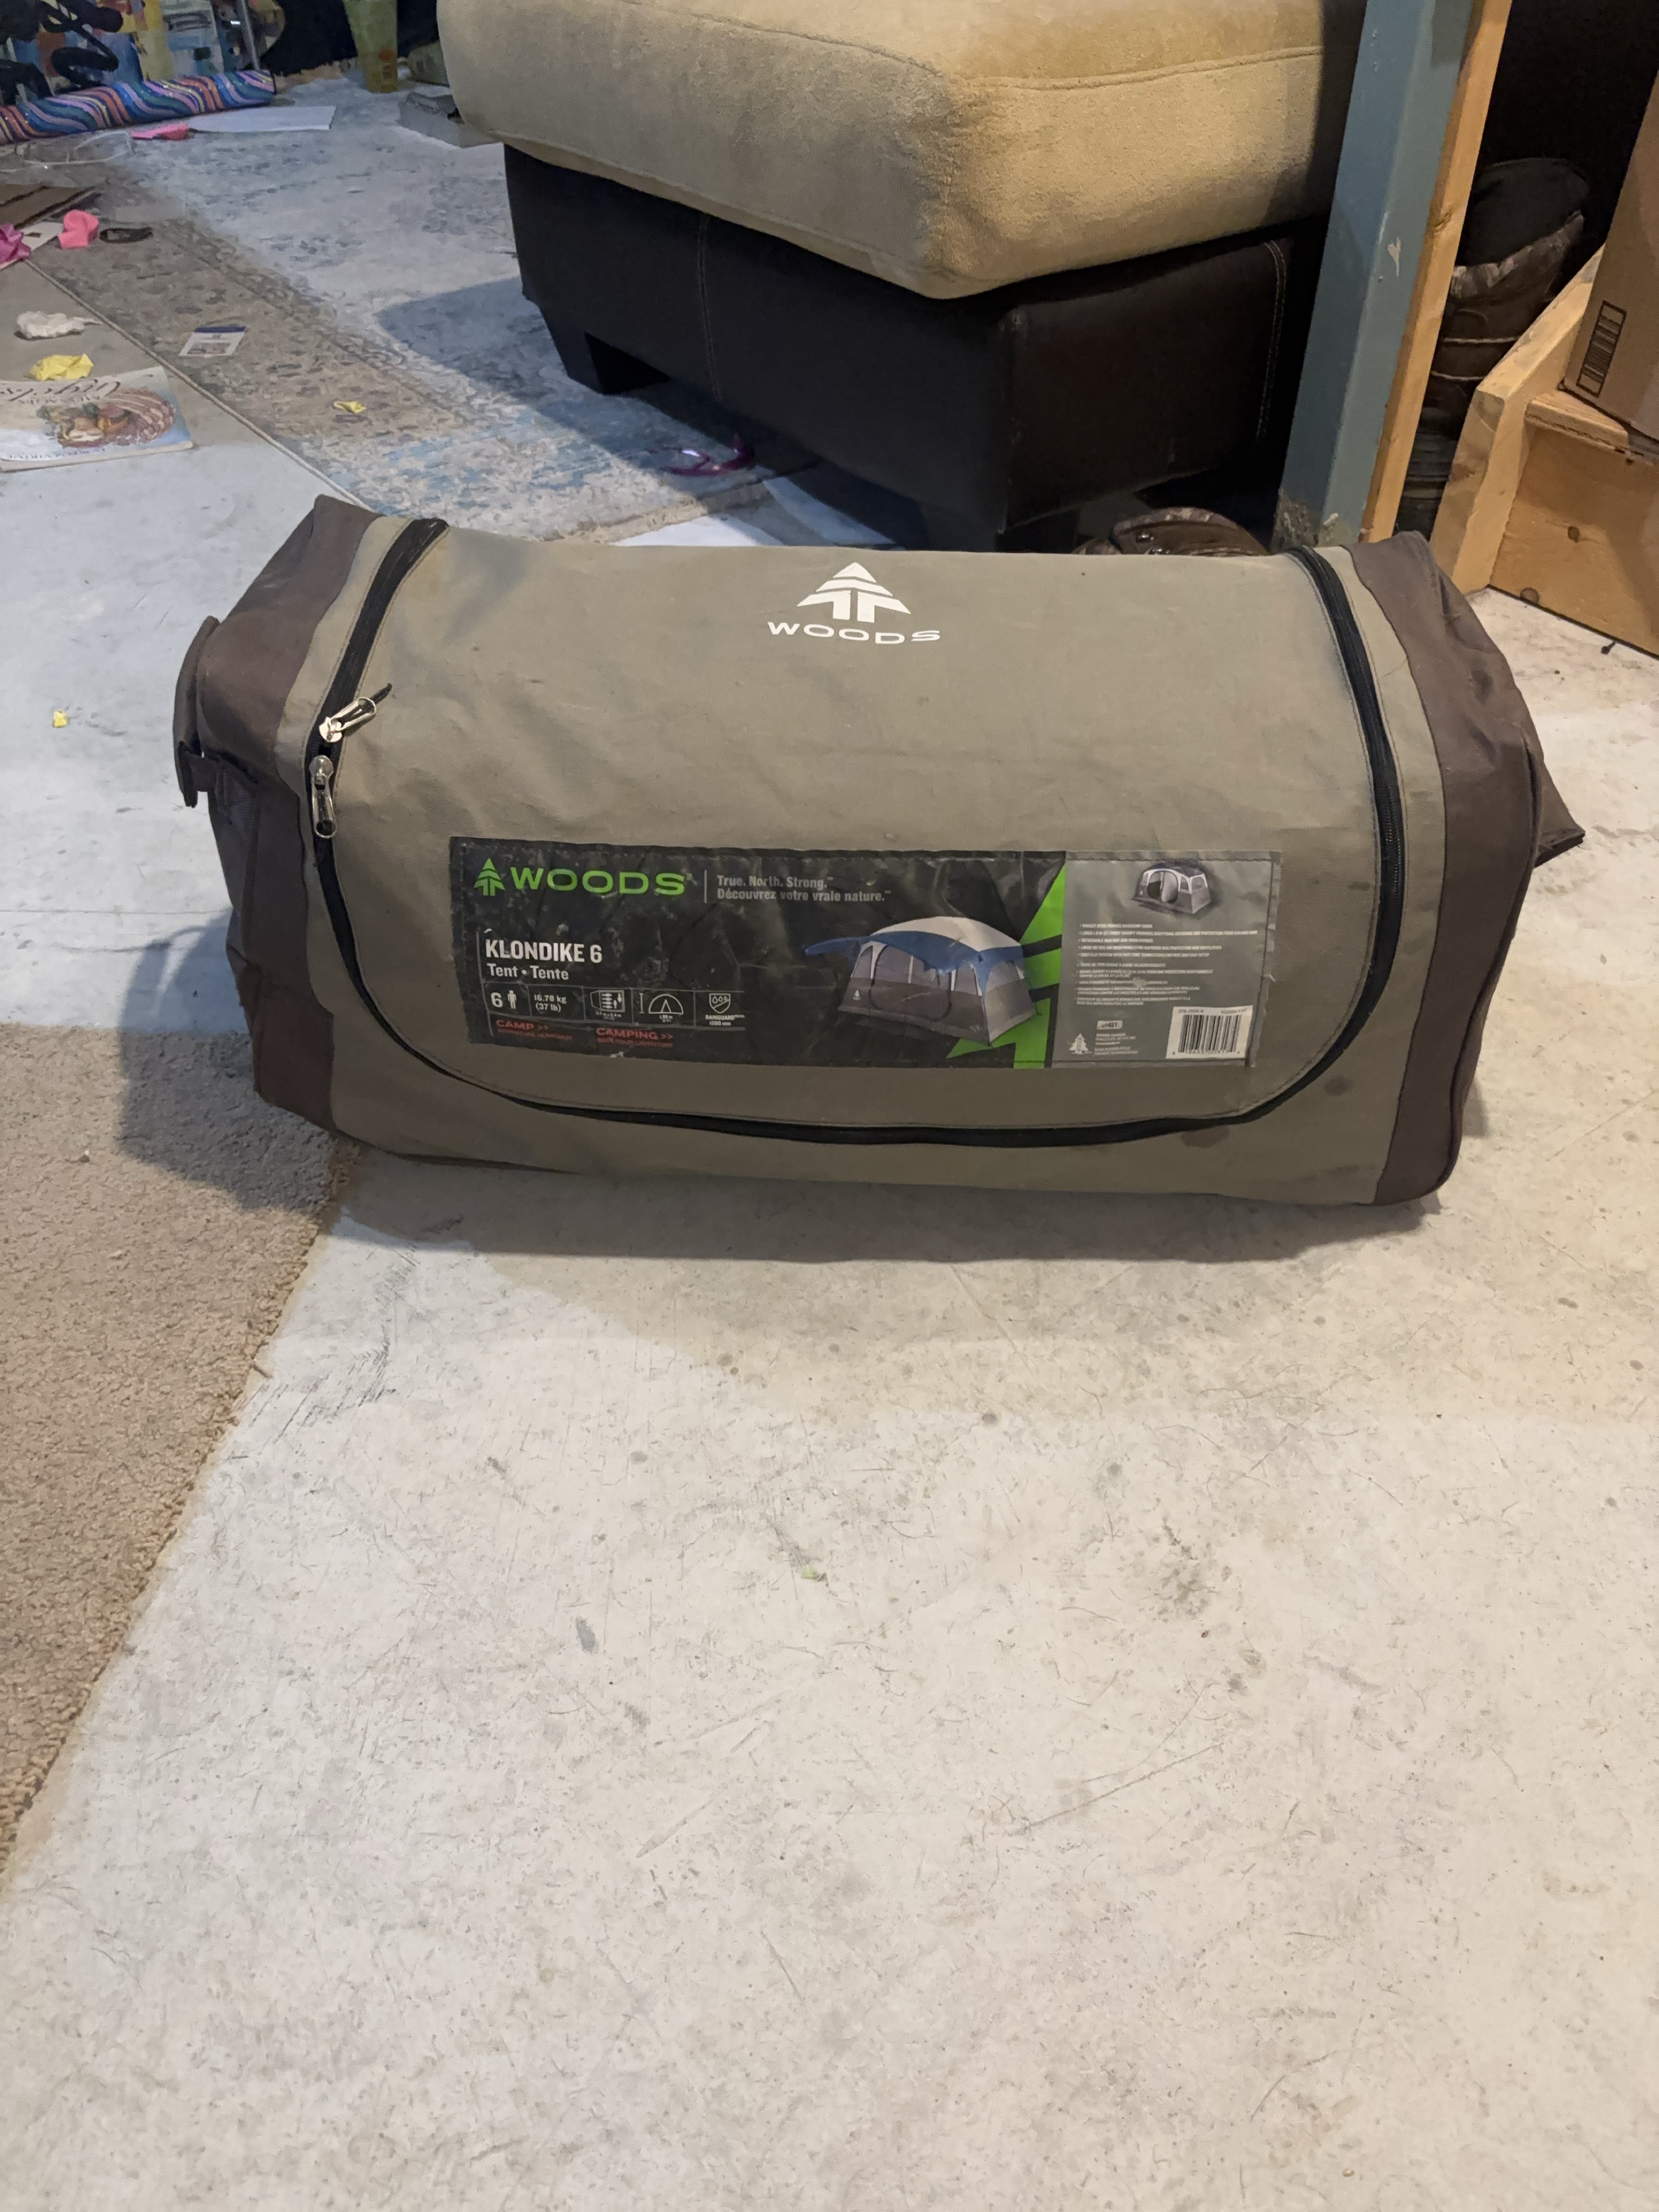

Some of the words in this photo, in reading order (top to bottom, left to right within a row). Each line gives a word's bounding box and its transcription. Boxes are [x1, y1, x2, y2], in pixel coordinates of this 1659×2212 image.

[768, 622, 940, 644] WOODS
[511, 867, 685, 896] WOODS
[717, 875, 746, 887] True.
[749, 876, 783, 887] North.
[717, 888, 776, 900] Découvrez
[780, 890, 809, 901] votre
[813, 890, 841, 902] vraie
[485, 939, 585, 963] KLONDIKE
[590, 944, 603, 963] 6
[487, 963, 518, 977] Tent
[529, 965, 569, 981] Tente
[491, 992, 503, 1008] 6
[557, 995, 567, 1005] kg
[535, 1003, 548, 1011] (37
[550, 1003, 562, 1013] lb)
[496, 1020, 535, 1030] CAMP
[596, 1028, 658, 1040] CAMPING
